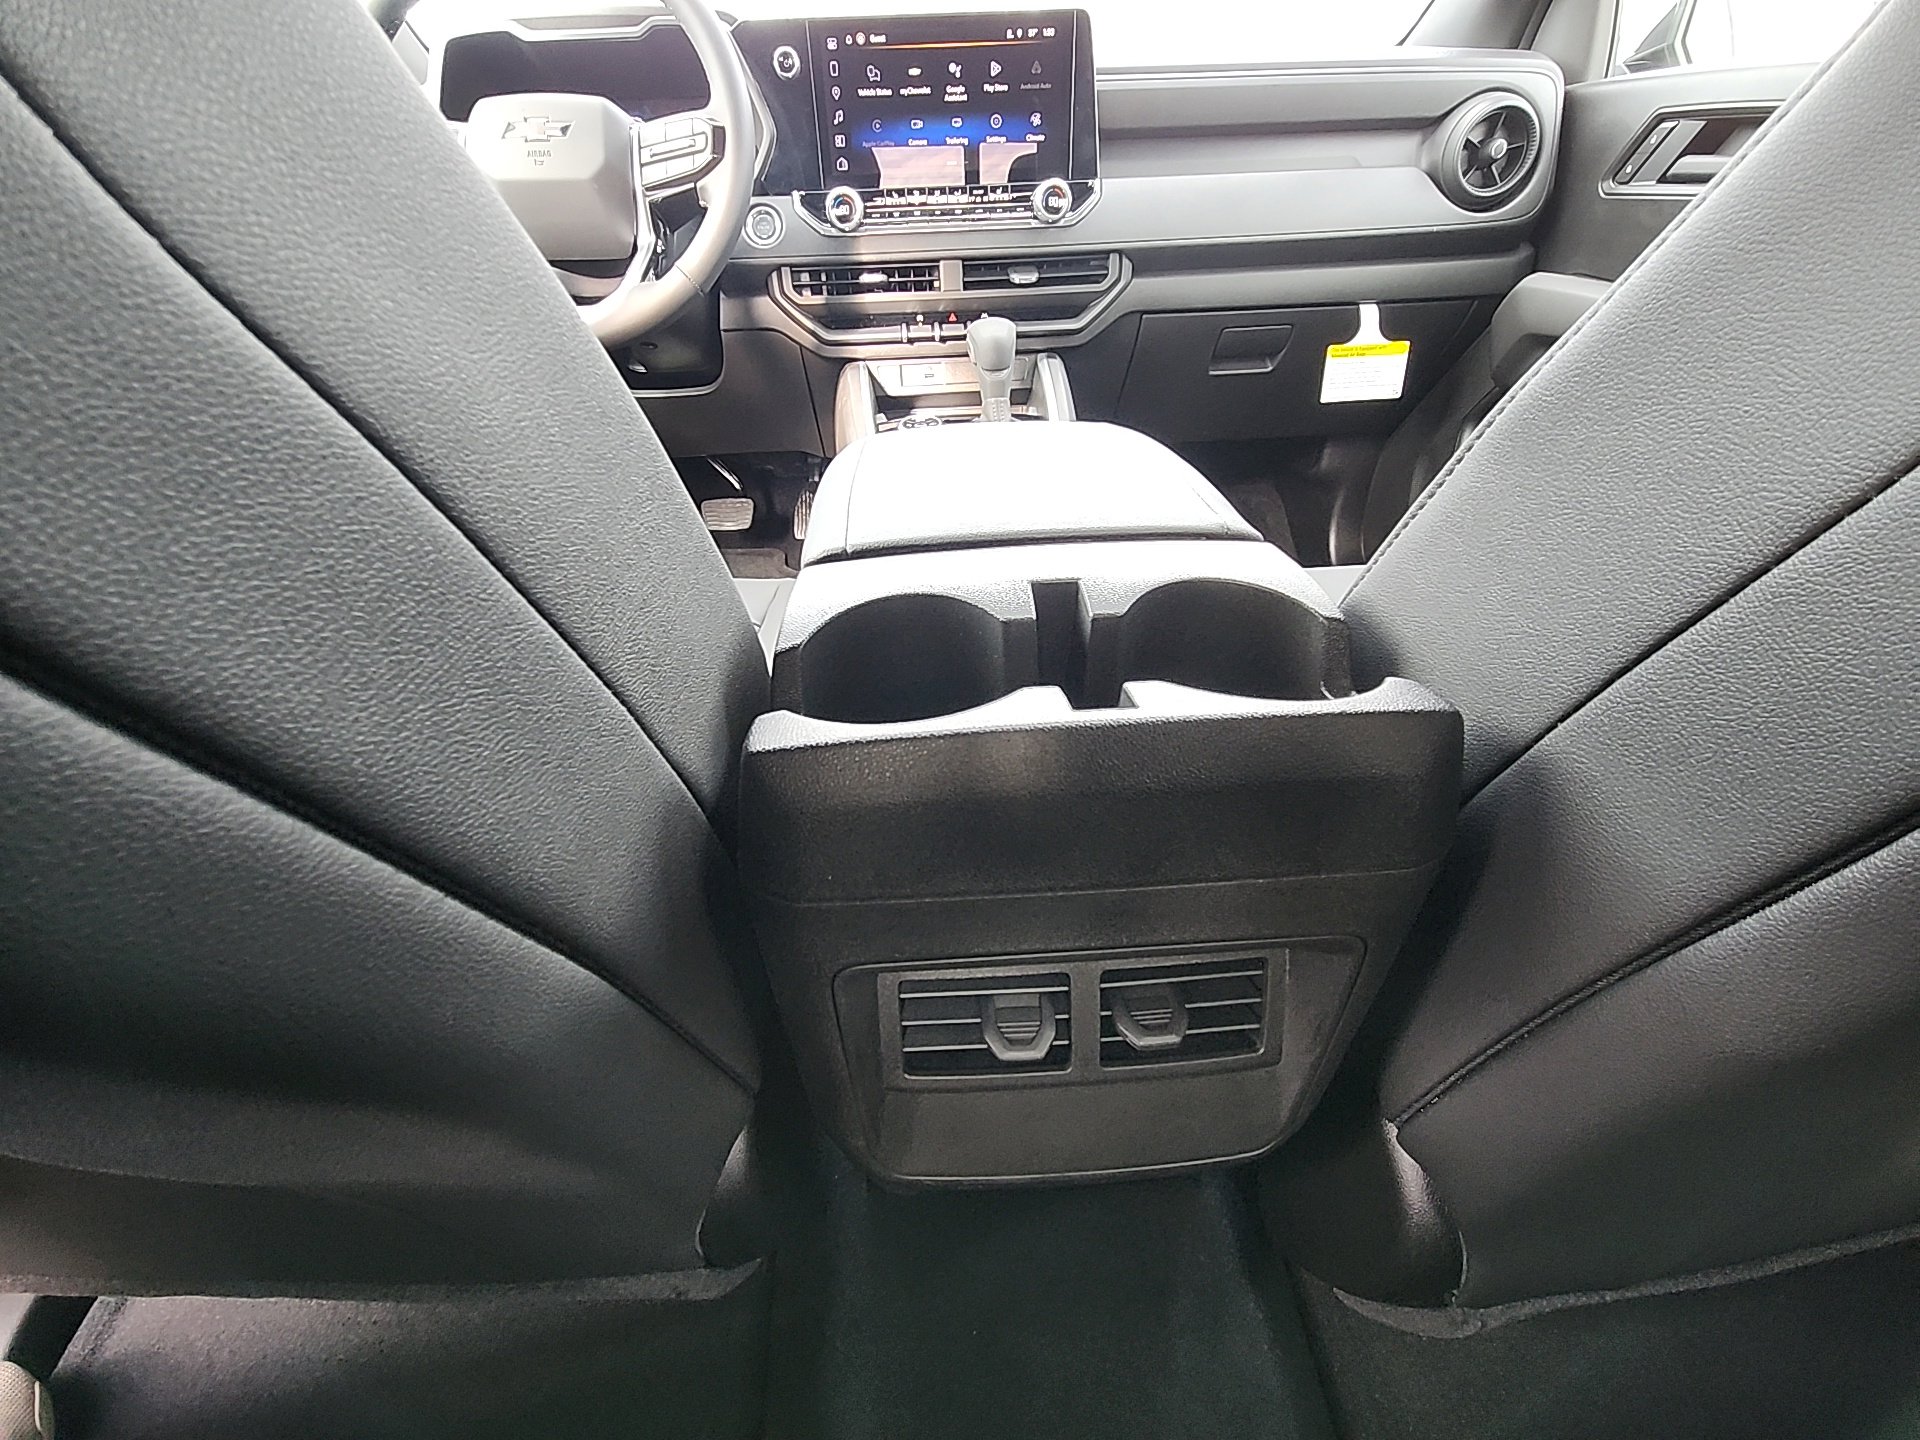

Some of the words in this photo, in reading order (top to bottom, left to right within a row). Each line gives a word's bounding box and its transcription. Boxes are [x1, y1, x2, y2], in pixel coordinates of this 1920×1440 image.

[857, 88, 876, 96] Vehicle
[876, 87, 893, 96] Status
[899, 86, 932, 97] myChevrolet
[945, 84, 966, 94] Google
[983, 83, 994, 94] Play
[994, 83, 1009, 92] Store
[943, 93, 968, 102] Assistant
